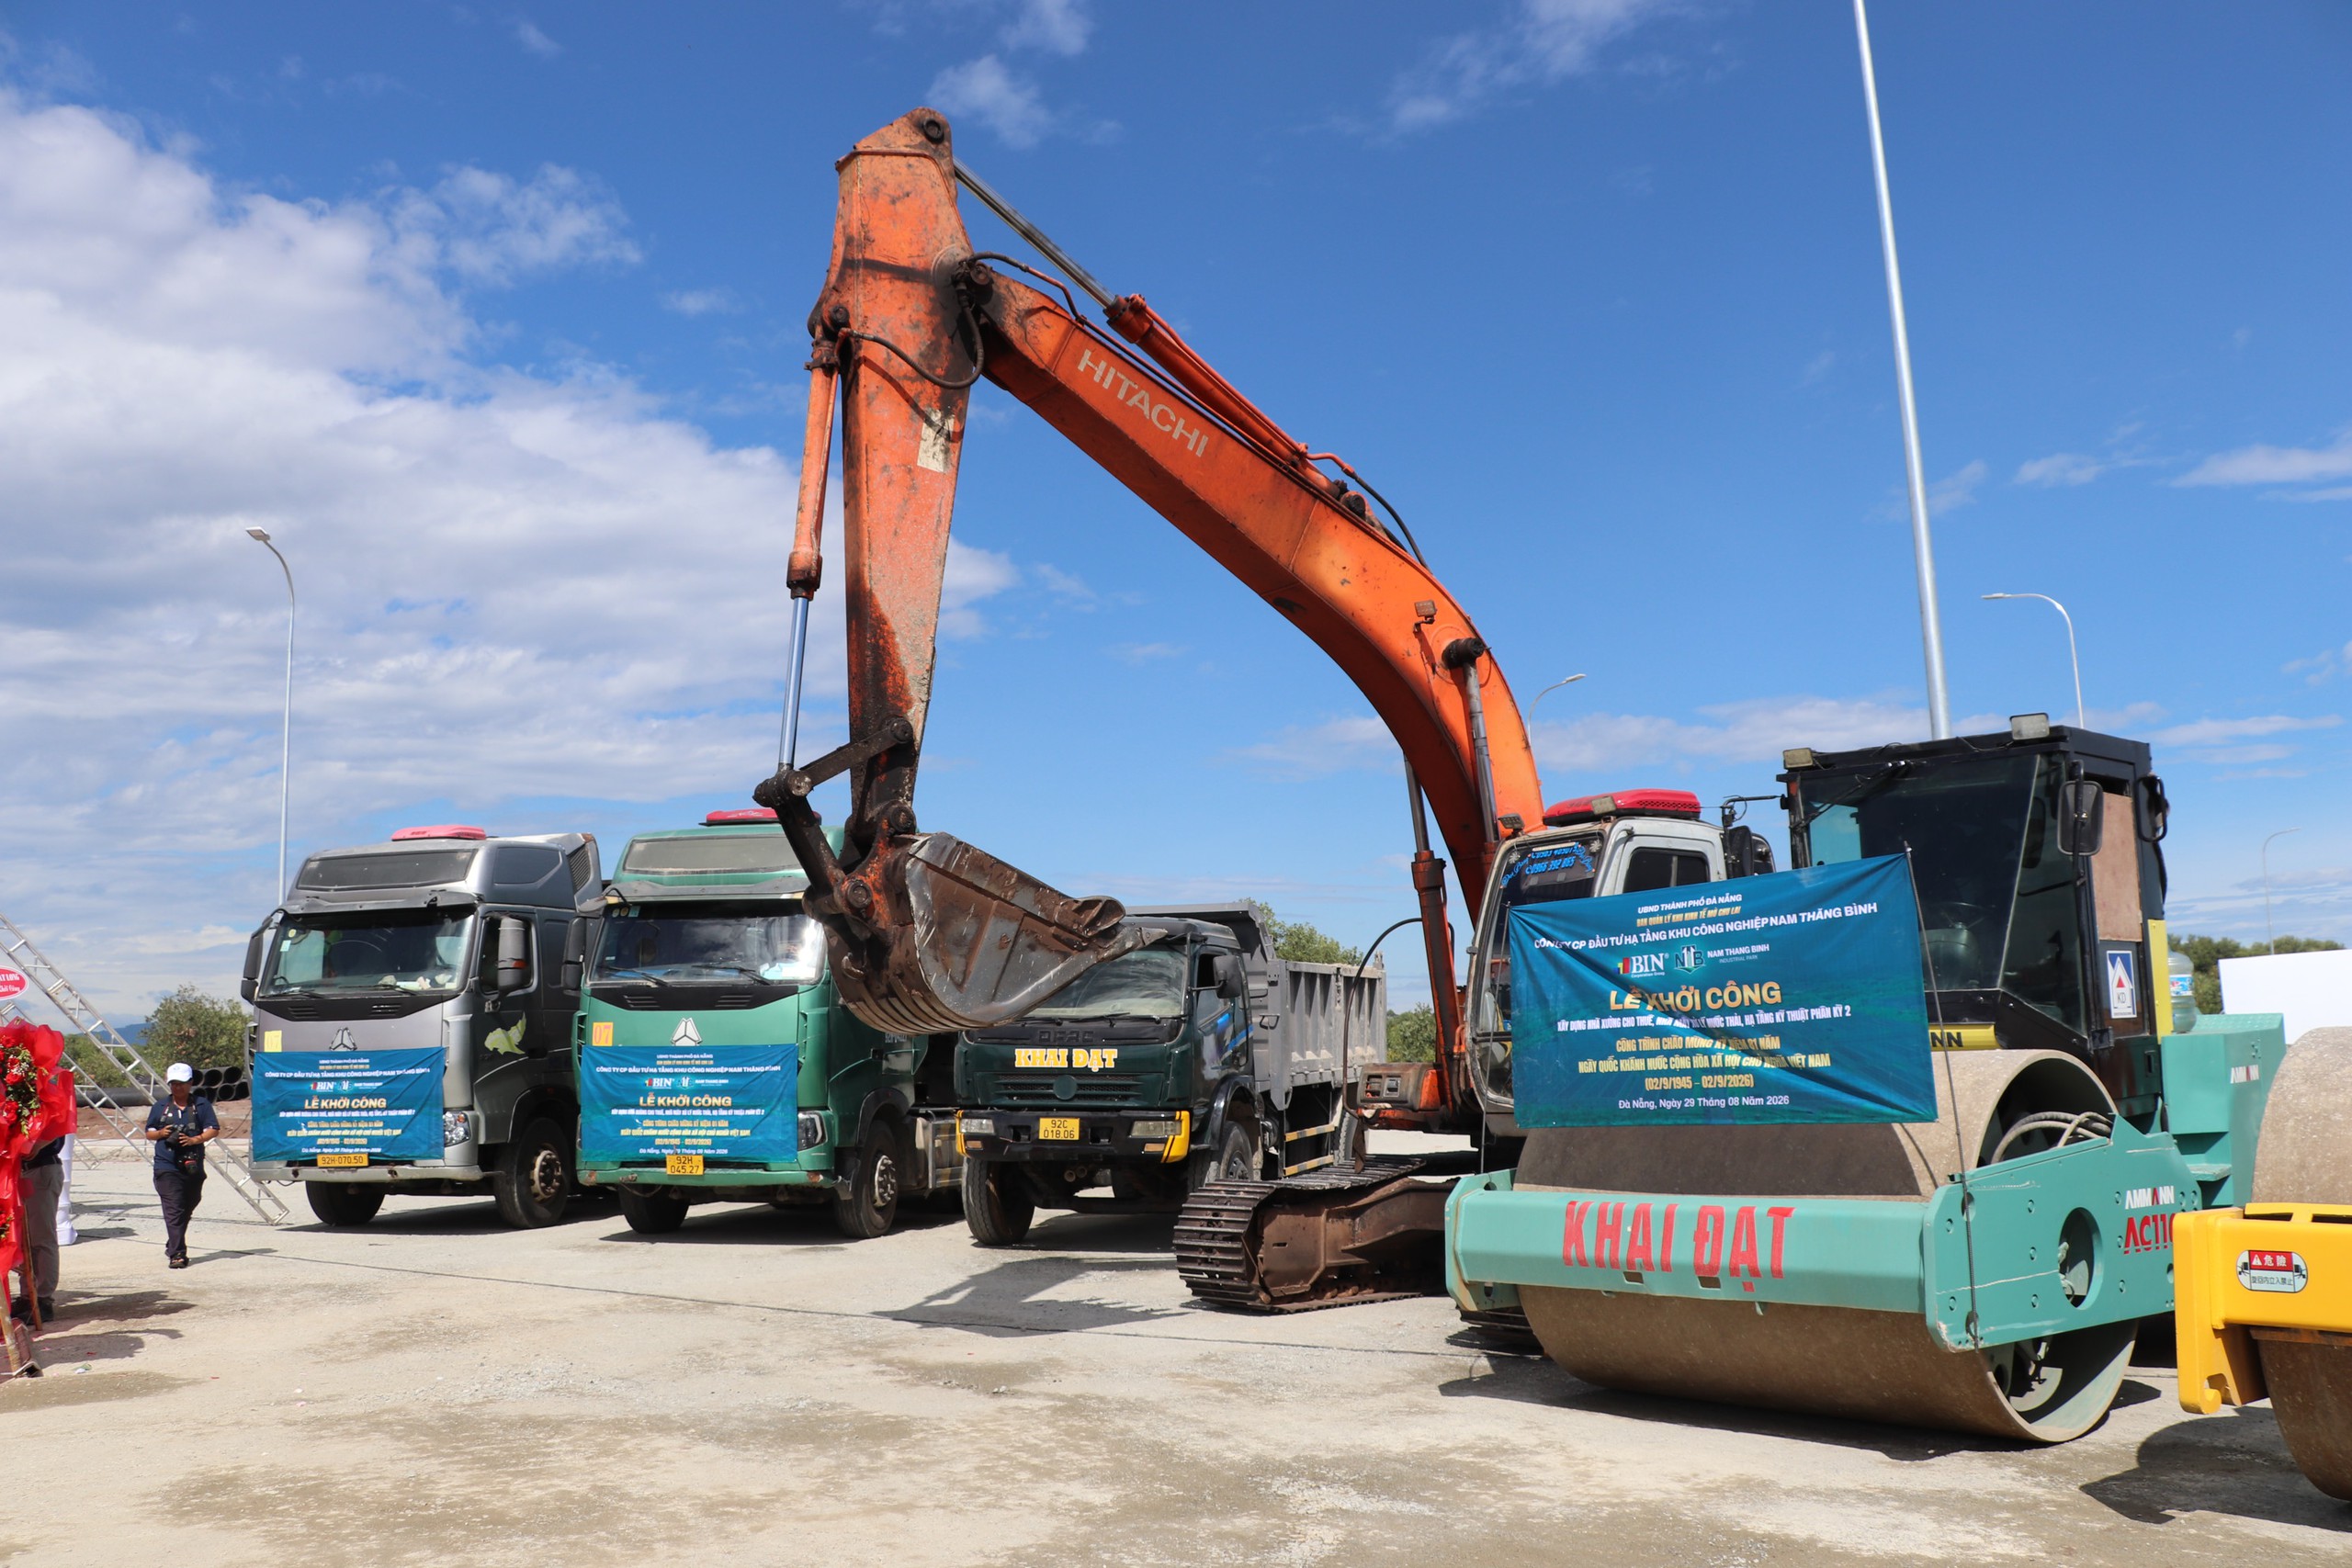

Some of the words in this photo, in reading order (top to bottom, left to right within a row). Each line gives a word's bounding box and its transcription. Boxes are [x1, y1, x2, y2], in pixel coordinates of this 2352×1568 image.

[1077, 348, 1209, 457] HITACHI
[1638, 906, 1659, 914] UBND
[1660, 901, 1687, 911] THÀNH
[1688, 897, 1705, 908] PHỐ
[1706, 896, 1717, 905] ĐÀ
[1718, 892, 1742, 903] NẴNG
[1572, 940, 1586, 950] CP
[1589, 934, 1609, 949] ĐẦU
[1609, 934, 1624, 946] TƯ
[1624, 933, 1638, 946] HẠ
[1639, 928, 1667, 943] TẦNG
[1668, 928, 1690, 939] KHU
[1692, 922, 1724, 935] CÔNG
[1725, 915, 1769, 932] NGHIỆP
[1770, 913, 1798, 927] NAM
[1799, 907, 1842, 923] THĂNG
[1844, 901, 1878, 918] BÌNH
[1707, 949, 1724, 958] NAM
[1725, 946, 1750, 956] THANG
[1751, 943, 1770, 953] BINH
[1632, 952, 1665, 974] BIN
[1610, 985, 1642, 1010] LỄ
[1645, 985, 1702, 1012] KHỞI
[1705, 980, 1781, 1010] CÔNG
[1557, 1019, 1569, 1032] XÂY
[1622, 1016, 1635, 1028] CHO
[1744, 1014, 1755, 1027] HẠ
[1755, 1010, 1774, 1024] TẦNG
[1786, 1007, 1809, 1022] THUẬT
[1845, 1005, 1851, 1017] 2
[594, 1023, 612, 1044] 07
[1616, 1037, 1636, 1052] CÔNG
[1758, 1034, 1781, 1050] NĂM
[1014, 1048, 1069, 1067] KHAI
[1072, 1048, 1118, 1072] ĐẠT
[1669, 1054, 1691, 1071] CỘNG
[1711, 1052, 1723, 1068] XÃ
[1724, 1054, 1741, 1069] HỘI
[1787, 1053, 1806, 1068] VIỆT
[1808, 1053, 1831, 1067] NAM
[653, 1077, 672, 1088] BIN
[1645, 1076, 1692, 1090] (02/9/1945
[1702, 1073, 1755, 1089] 02/9/2026)
[304, 1094, 319, 1109] LỄ
[321, 1096, 350, 1109] KHỞI
[351, 1095, 387, 1109] CÔNG
[639, 1092, 655, 1107] LỄ
[657, 1093, 690, 1107] KHỞI
[692, 1093, 732, 1107] CÔNG
[1619, 1099, 1631, 1109] Đà
[1632, 1097, 1657, 1110] Nẵng,
[1659, 1098, 1682, 1110] Ngày
[1684, 1098, 1695, 1107] 29
[1697, 1096, 1726, 1108] Tháng
[1728, 1097, 1739, 1106] 08
[1741, 1095, 1764, 1106] Năm
[1767, 1095, 1790, 1105] 2026
[1050, 1119, 1069, 1129] 92C
[1044, 1129, 1075, 1139] 018.06
[322, 1156, 363, 1165] 92H-070.50
[670, 1165, 700, 1174] 045.27
[676, 1156, 693, 1165] 92H
[2125, 1185, 2175, 1210] AMMANN
[1563, 1200, 1679, 1272] KHAI
[1693, 1205, 1797, 1292] ĐẠT
